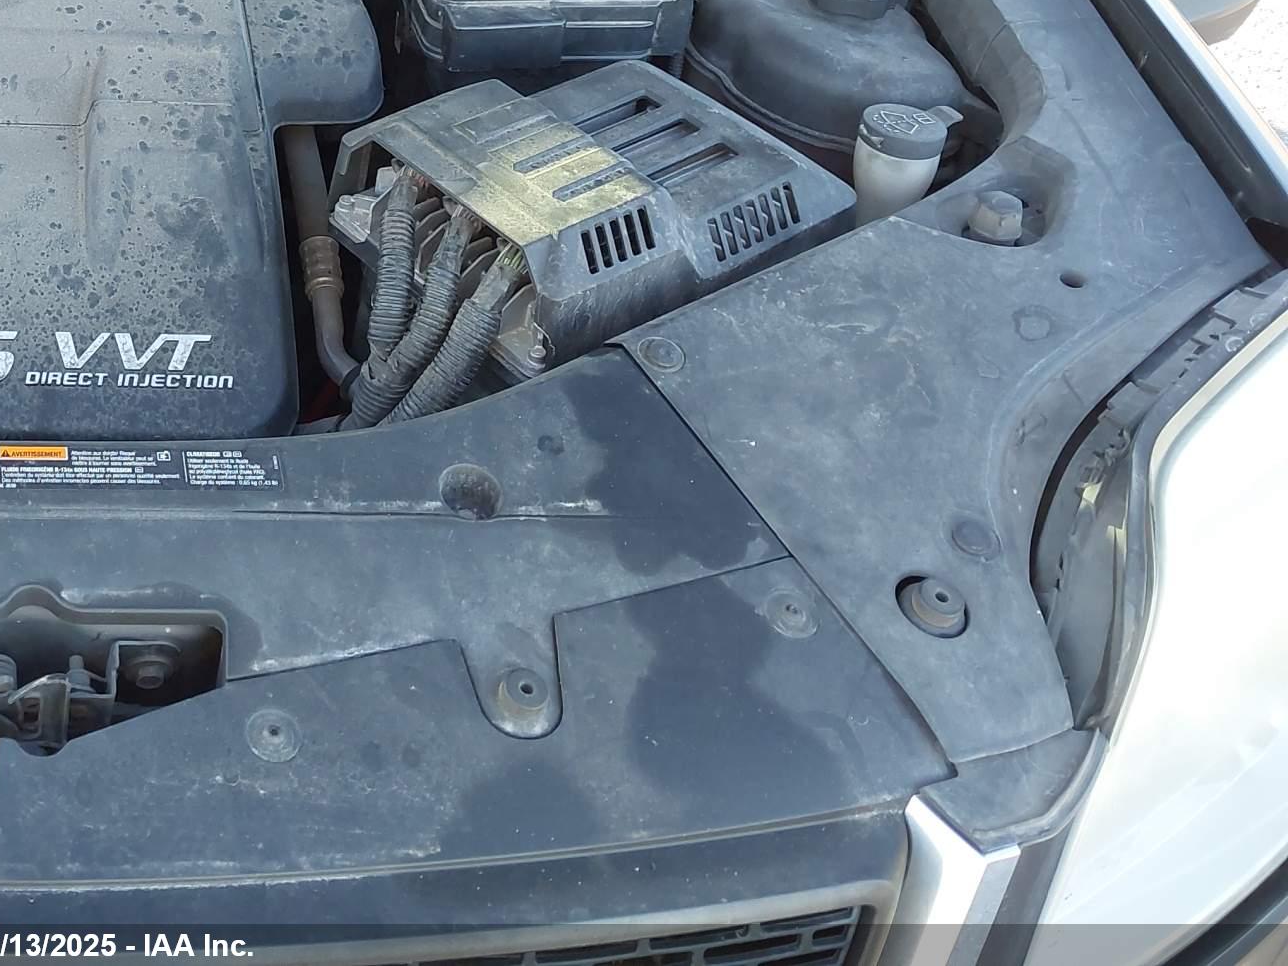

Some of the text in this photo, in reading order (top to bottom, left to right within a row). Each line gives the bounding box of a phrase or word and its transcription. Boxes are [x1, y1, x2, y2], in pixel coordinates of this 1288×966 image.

[55, 332, 212, 371] VVT
[25, 371, 234, 389] DIRECT INJECTION
